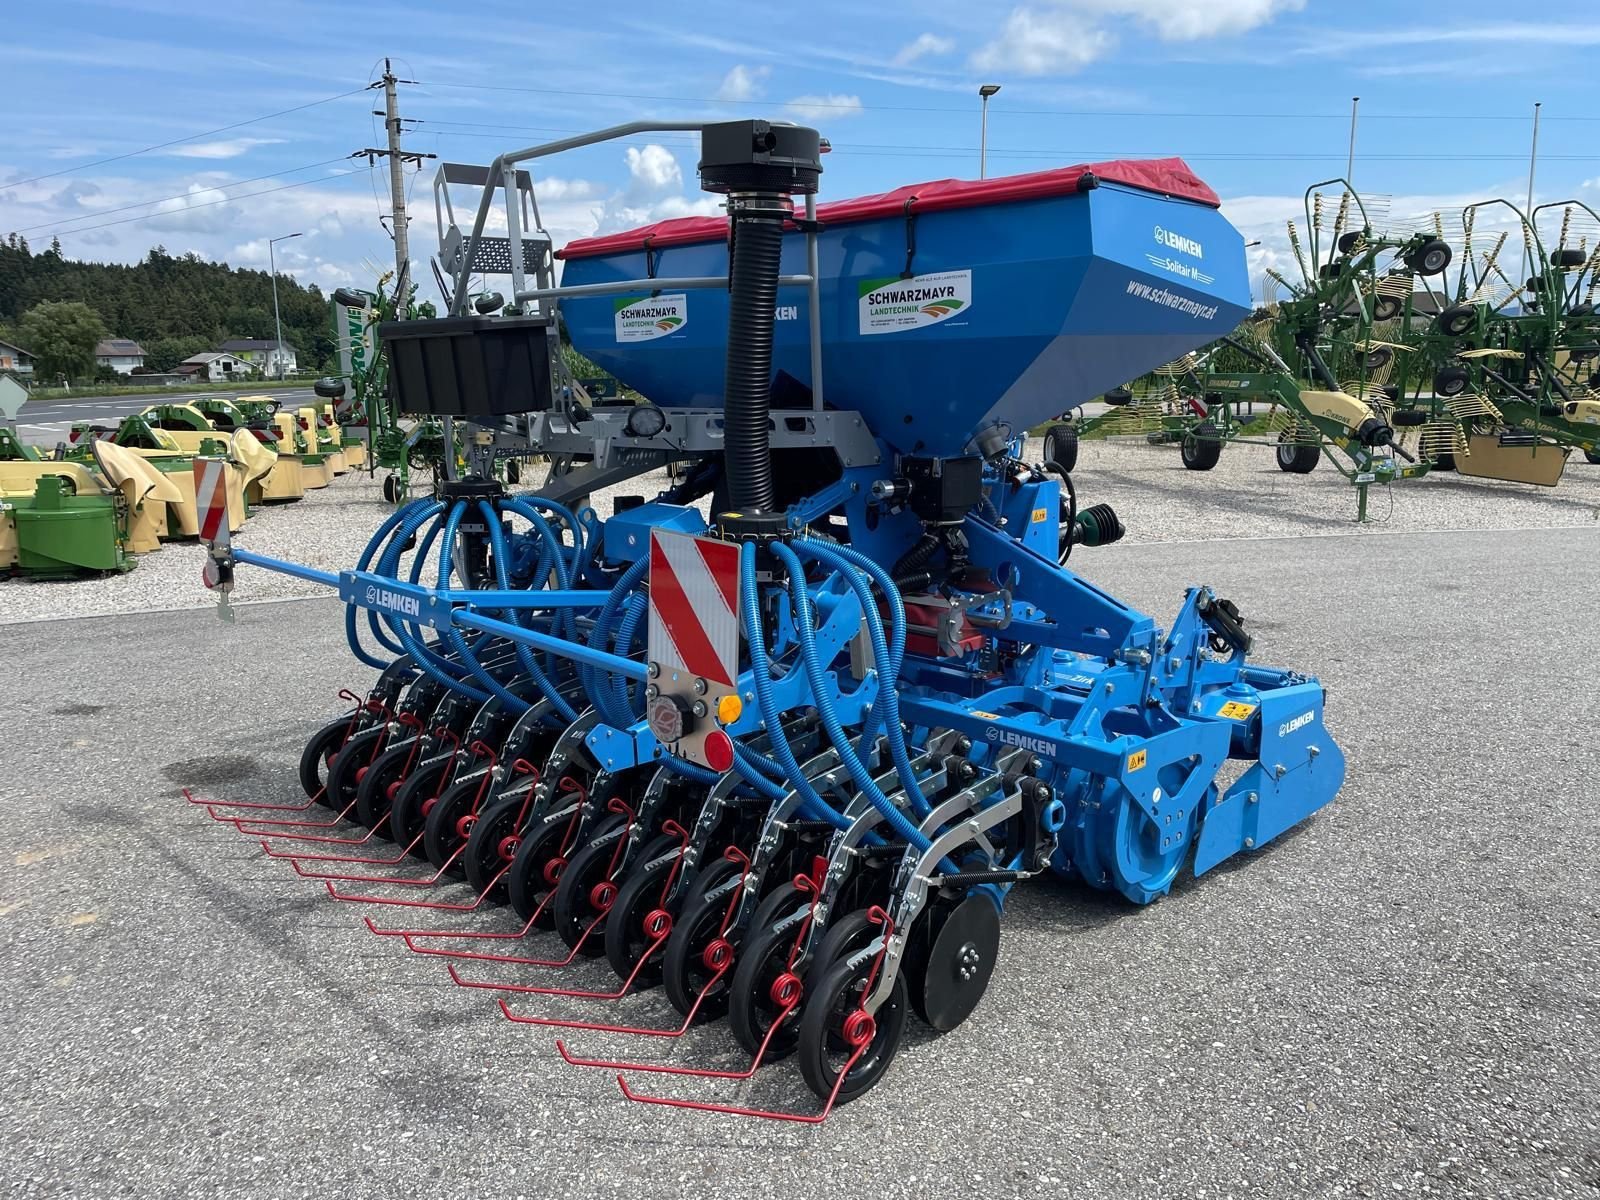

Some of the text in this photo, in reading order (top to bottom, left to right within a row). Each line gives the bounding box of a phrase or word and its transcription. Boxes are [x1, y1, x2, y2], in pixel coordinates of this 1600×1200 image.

[1164, 230, 1203, 258] LEMKEN
[1166, 258, 1198, 281] Solitair M
[868, 286, 955, 305] SCHWARZMAYR
[1126, 280, 1219, 320] www.schwarzmayr.at
[621, 307, 677, 319] SCHWARZMAYR
[870, 305, 919, 316] LANDTECHNIK
[622, 320, 655, 329] LANDTECHNIK
[1331, 413, 1351, 423] KRONE
[376, 588, 420, 617] LEMKEN
[1286, 710, 1315, 734] LEMKEN
[1000, 730, 1057, 758] LEMKEN
